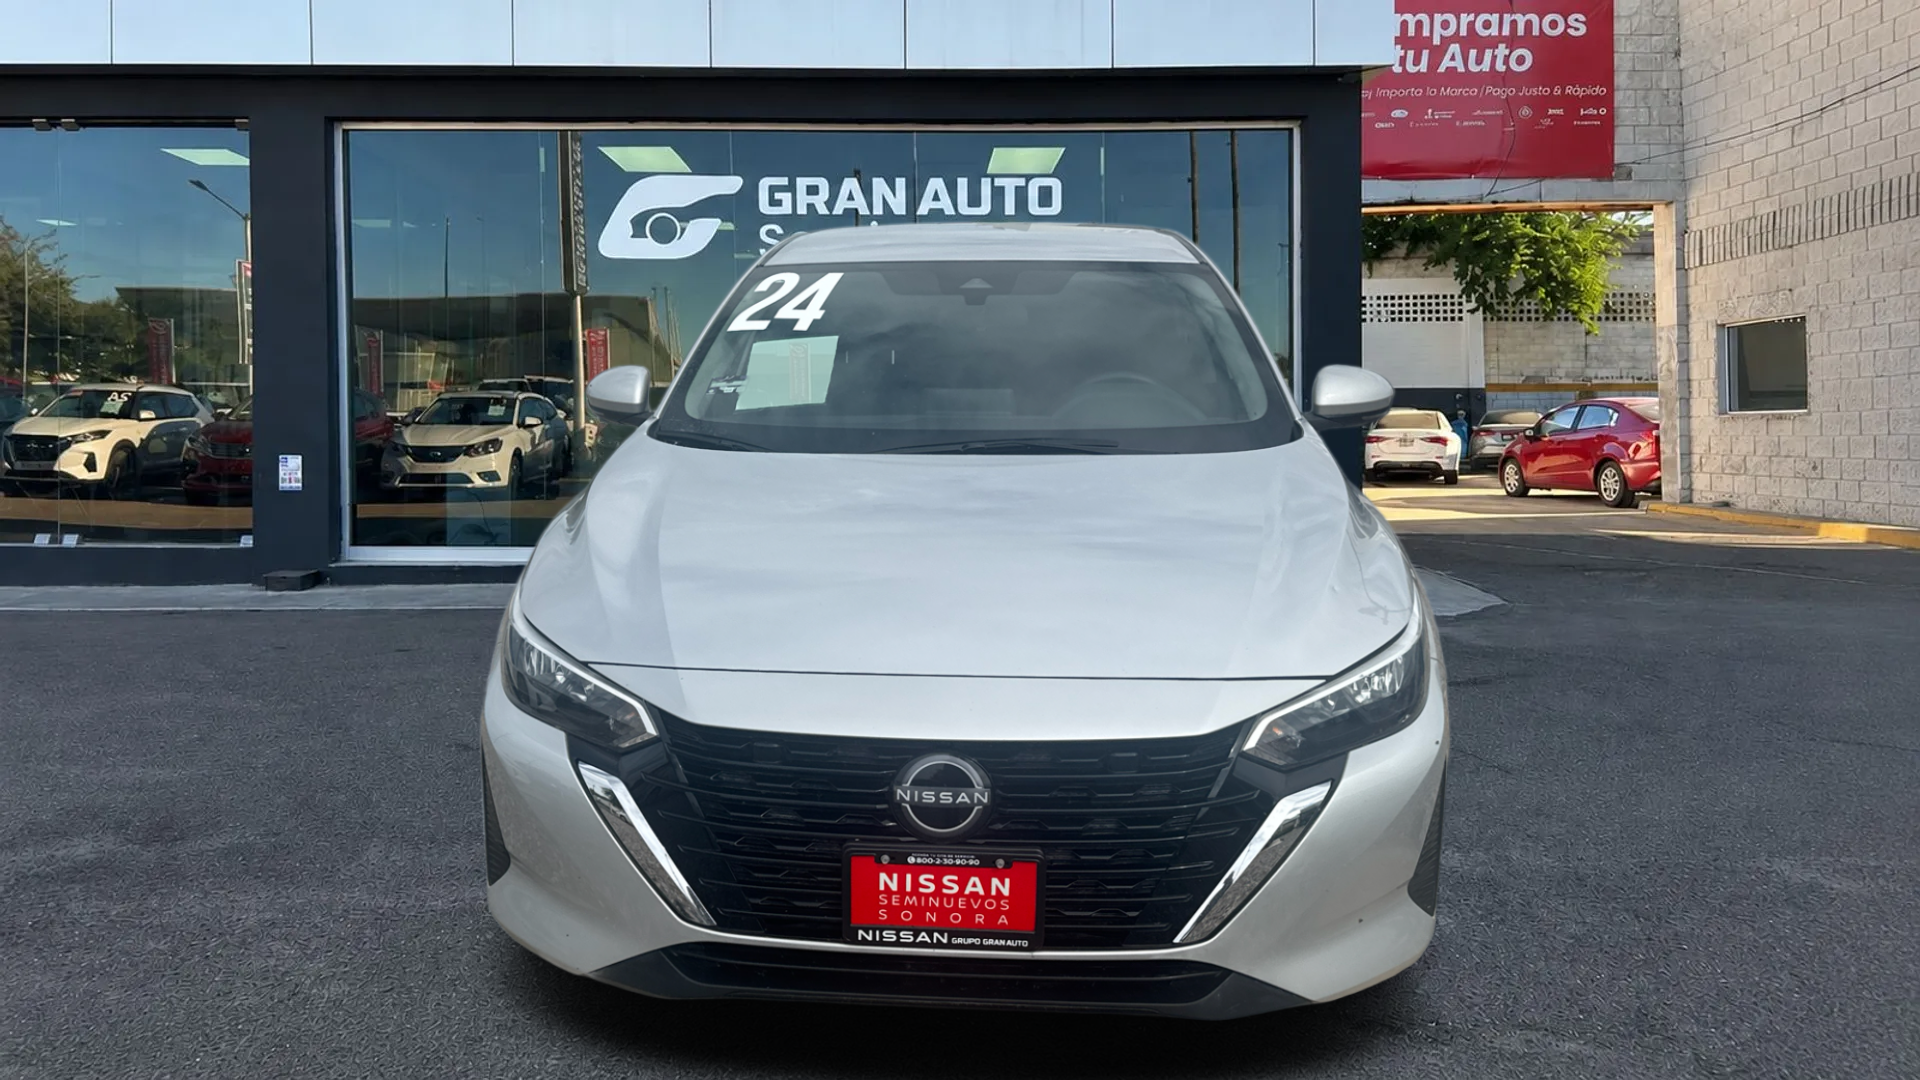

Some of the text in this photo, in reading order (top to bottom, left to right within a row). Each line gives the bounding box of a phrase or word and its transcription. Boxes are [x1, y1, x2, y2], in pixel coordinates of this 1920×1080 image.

[1392, 43, 1534, 74] tu Auto
[1375, 87, 1424, 99] Importa
[1426, 86, 1437, 97] la
[1439, 86, 1478, 97] Marca
[1518, 85, 1551, 96] Justo
[1553, 85, 1562, 96] &
[757, 177, 1063, 216] GRAN AUTO
[727, 272, 845, 332] 24
[896, 788, 989, 805] NISSAN
[878, 872, 1011, 897] NISSAN
[878, 893, 1010, 911] SEMINUEVOS
[878, 909, 1009, 926] SONORA
[857, 929, 949, 945] NISSAN
[951, 937, 981, 946] GRUPO
